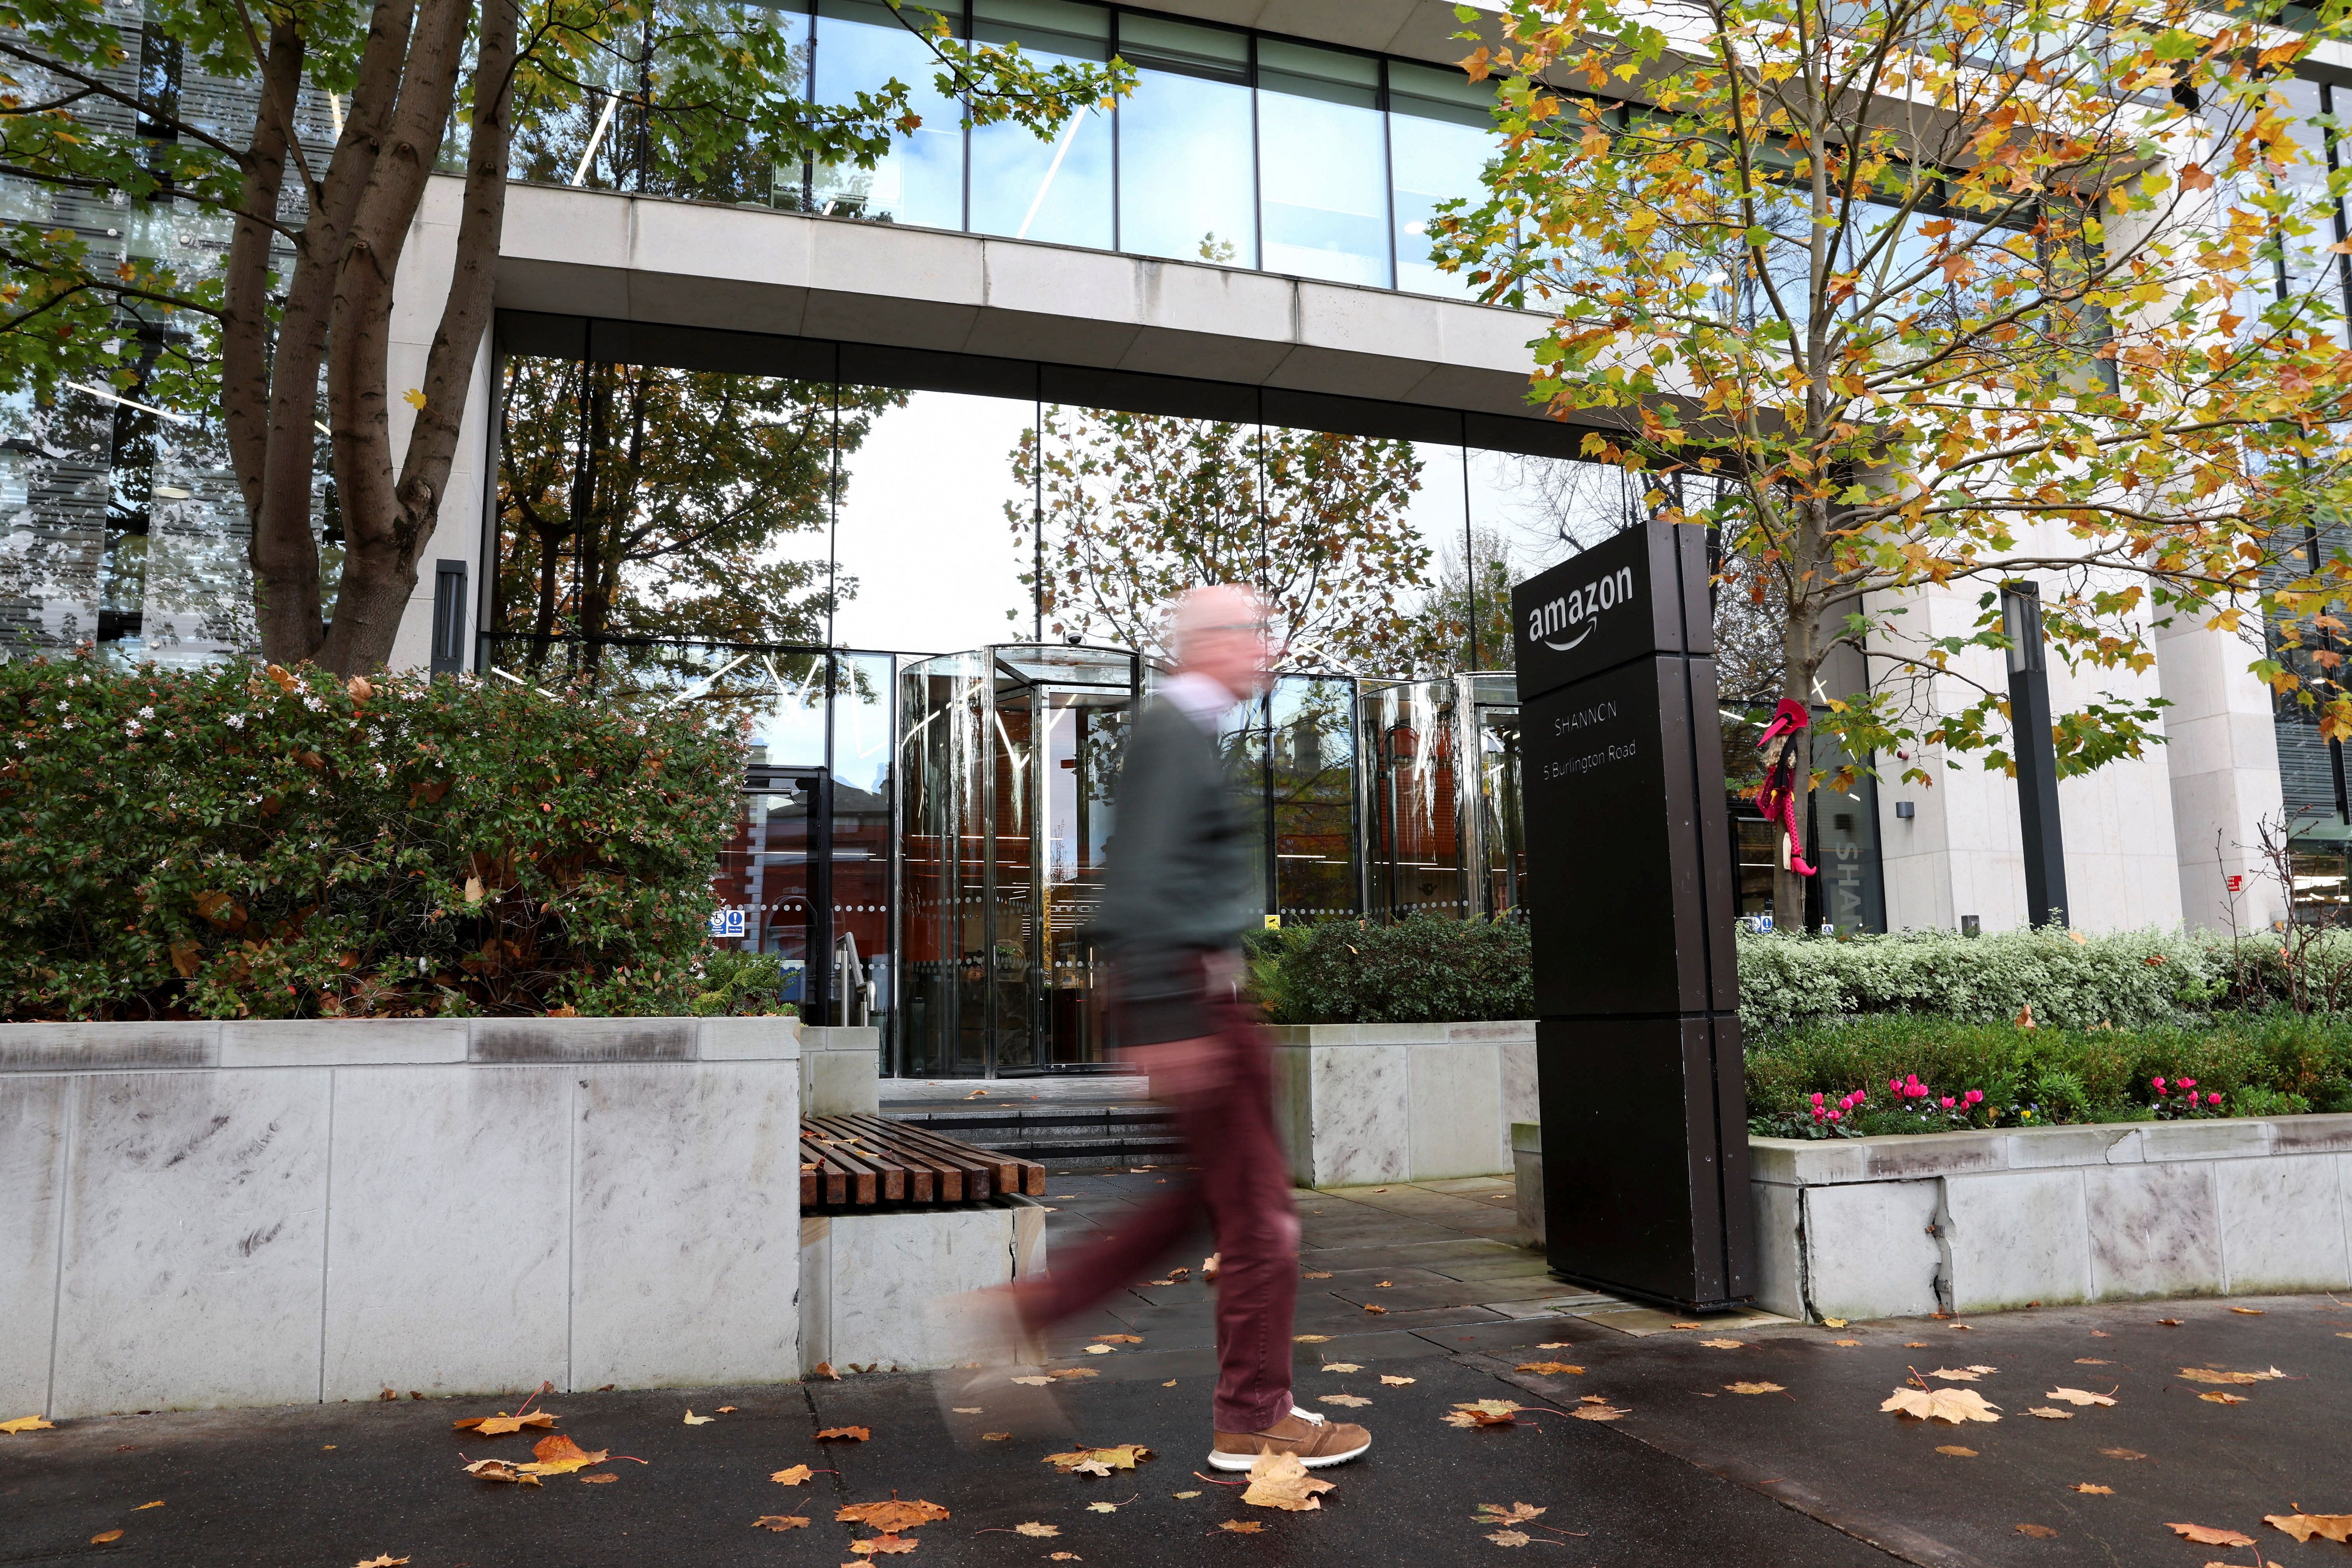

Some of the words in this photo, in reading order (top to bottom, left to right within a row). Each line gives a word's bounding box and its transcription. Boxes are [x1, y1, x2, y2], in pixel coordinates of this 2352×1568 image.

[1529, 566, 1633, 642] amazon
[1544, 765, 1549, 780] 5
[1553, 752, 1605, 777] Burlington
[1608, 738, 1636, 762] Road
